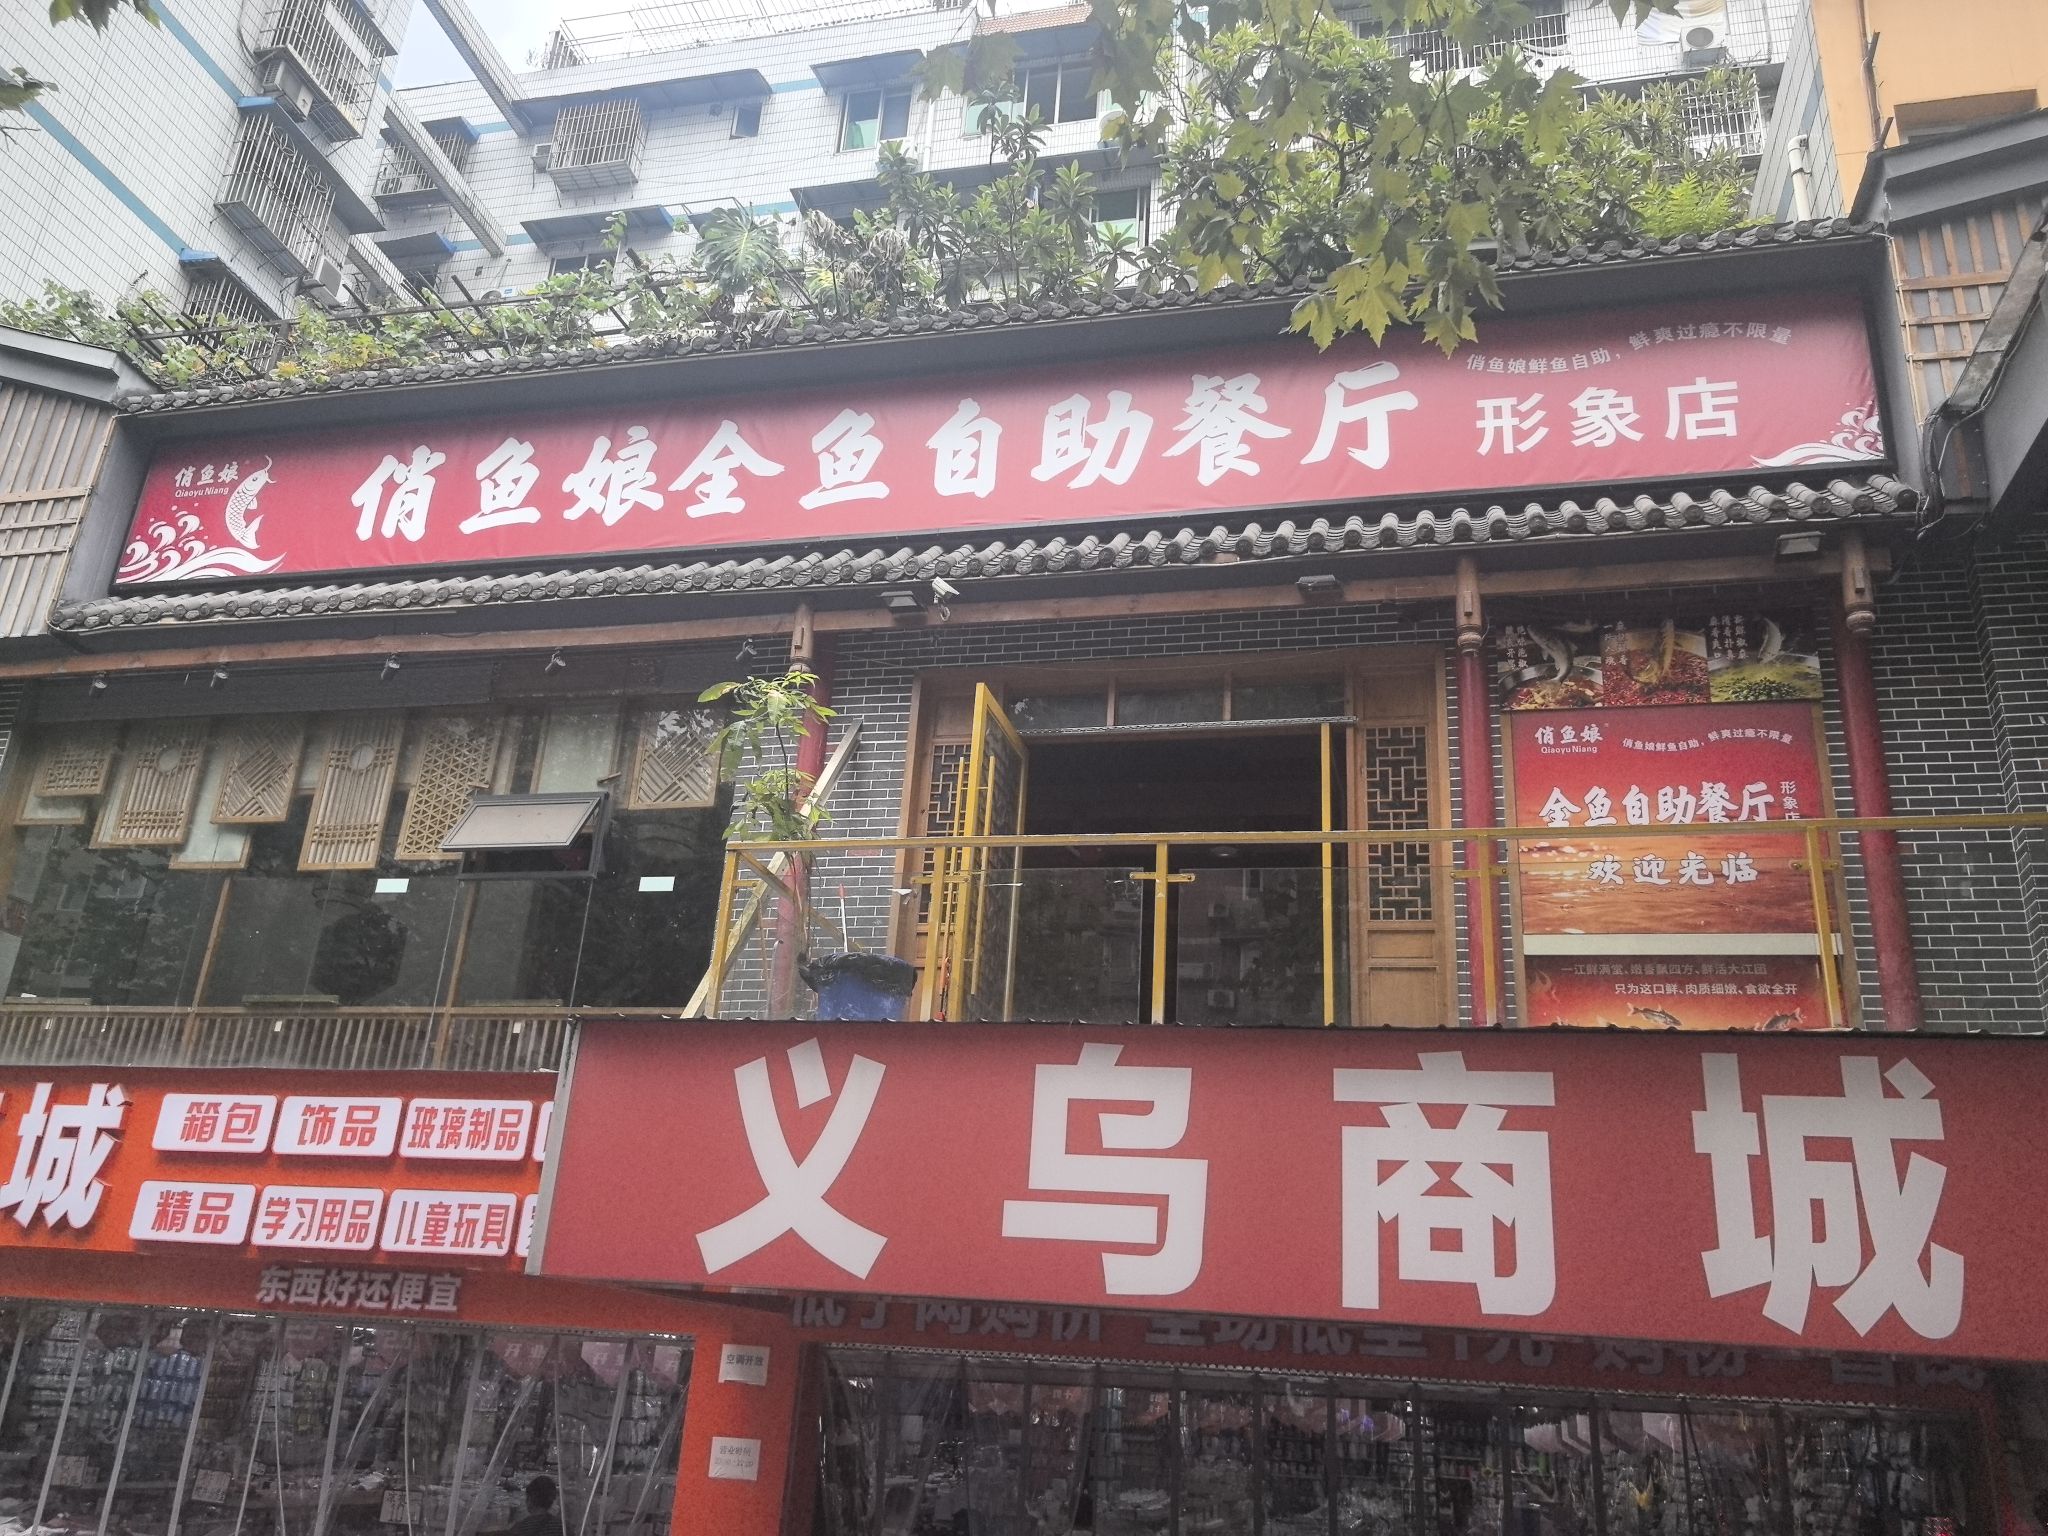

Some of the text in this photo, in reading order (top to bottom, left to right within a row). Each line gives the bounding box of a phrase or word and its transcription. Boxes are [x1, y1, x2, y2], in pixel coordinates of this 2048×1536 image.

[1475, 376, 1739, 456] 形象店
[351, 360, 1419, 542] 俏鱼娘全鱼自助餐厅
[174, 461, 239, 488] 俏鱼娘
[1535, 723, 1603, 745] 俏鱼娘
[1538, 781, 1775, 827] 全鱼自助餐厅
[1587, 850, 1759, 885] 欢迎光临
[182, 1101, 261, 1144] 箱包
[298, 1104, 381, 1147] 饰品
[408, 1106, 524, 1152] 玻璃制品
[0, 1081, 131, 1230] 城
[695, 1037, 1965, 1340] 义乌商城
[151, 1189, 235, 1236] 精品
[261, 1197, 374, 1244] 学习用品
[393, 1200, 511, 1250] 儿童玩具
[255, 1265, 463, 1313] 东西好还便宜
[726, 1352, 764, 1367] 空调开放
